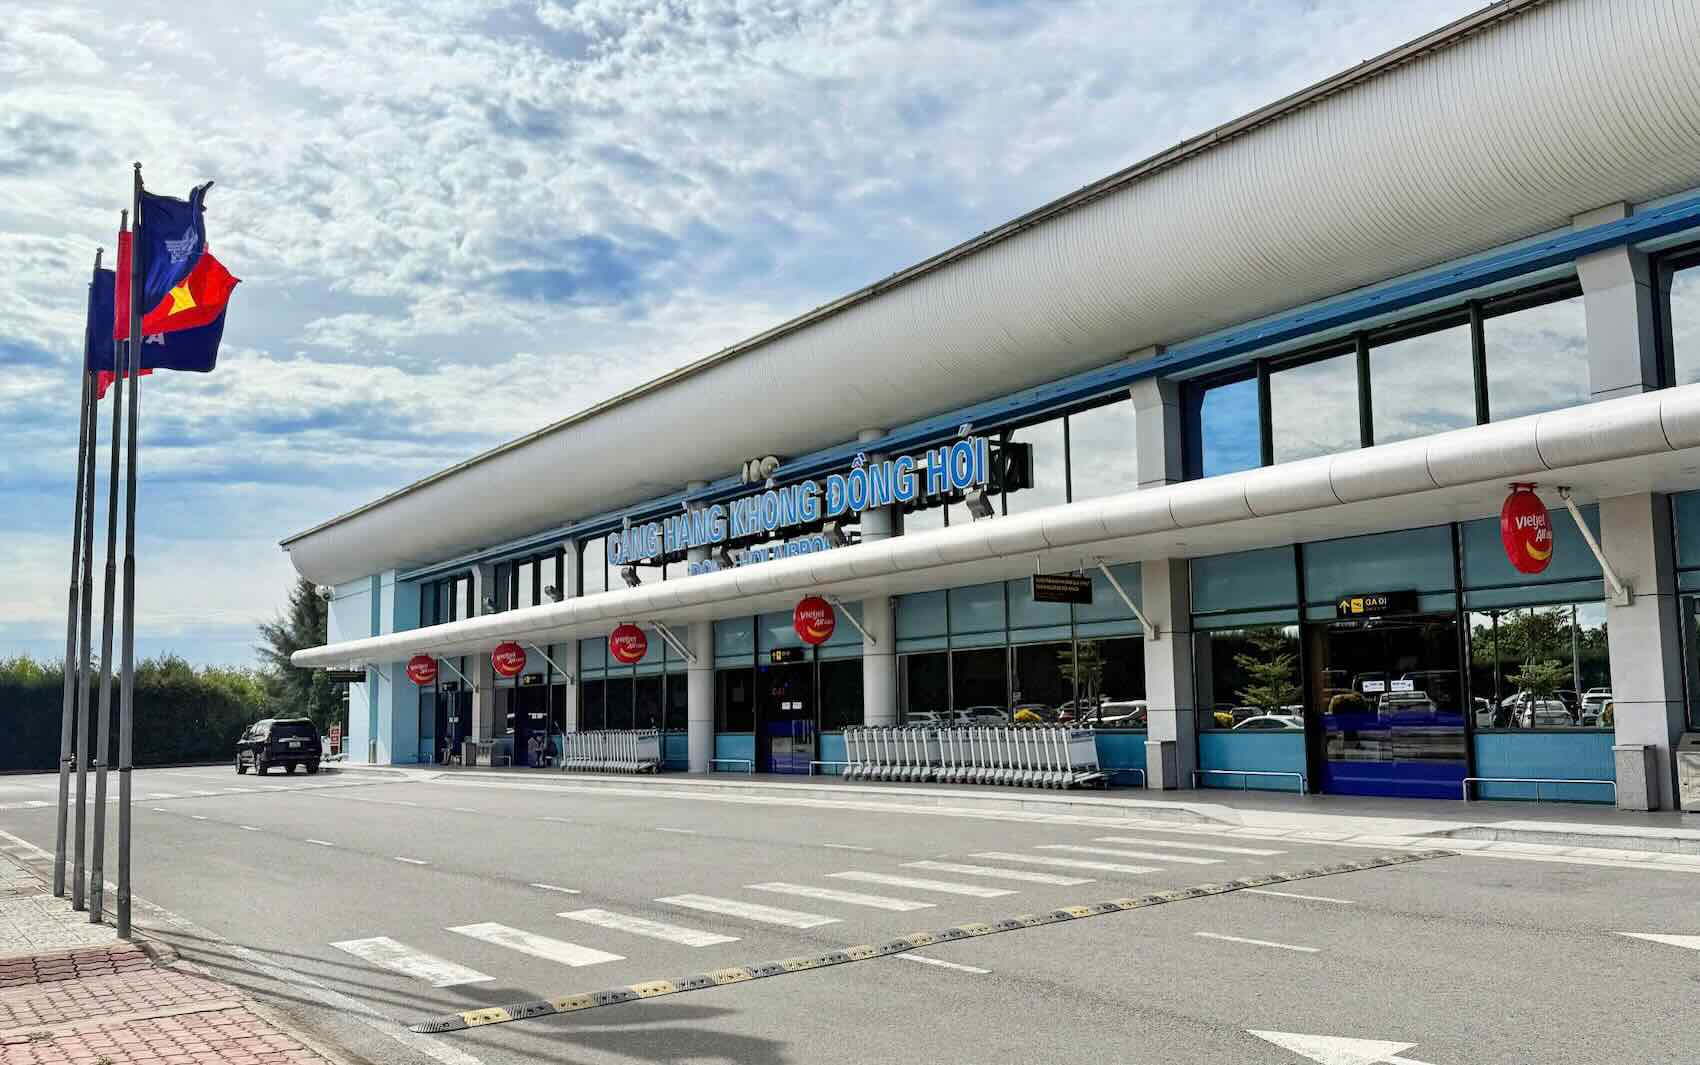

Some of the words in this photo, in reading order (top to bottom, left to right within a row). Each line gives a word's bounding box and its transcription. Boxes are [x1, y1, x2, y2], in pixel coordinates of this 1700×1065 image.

[608, 517, 658, 565] CẢNG
[664, 501, 725, 553] HÀNG
[730, 479, 817, 538] KHÔNG
[826, 452, 914, 517] ĐỒNG
[926, 424, 986, 496] HỚI
